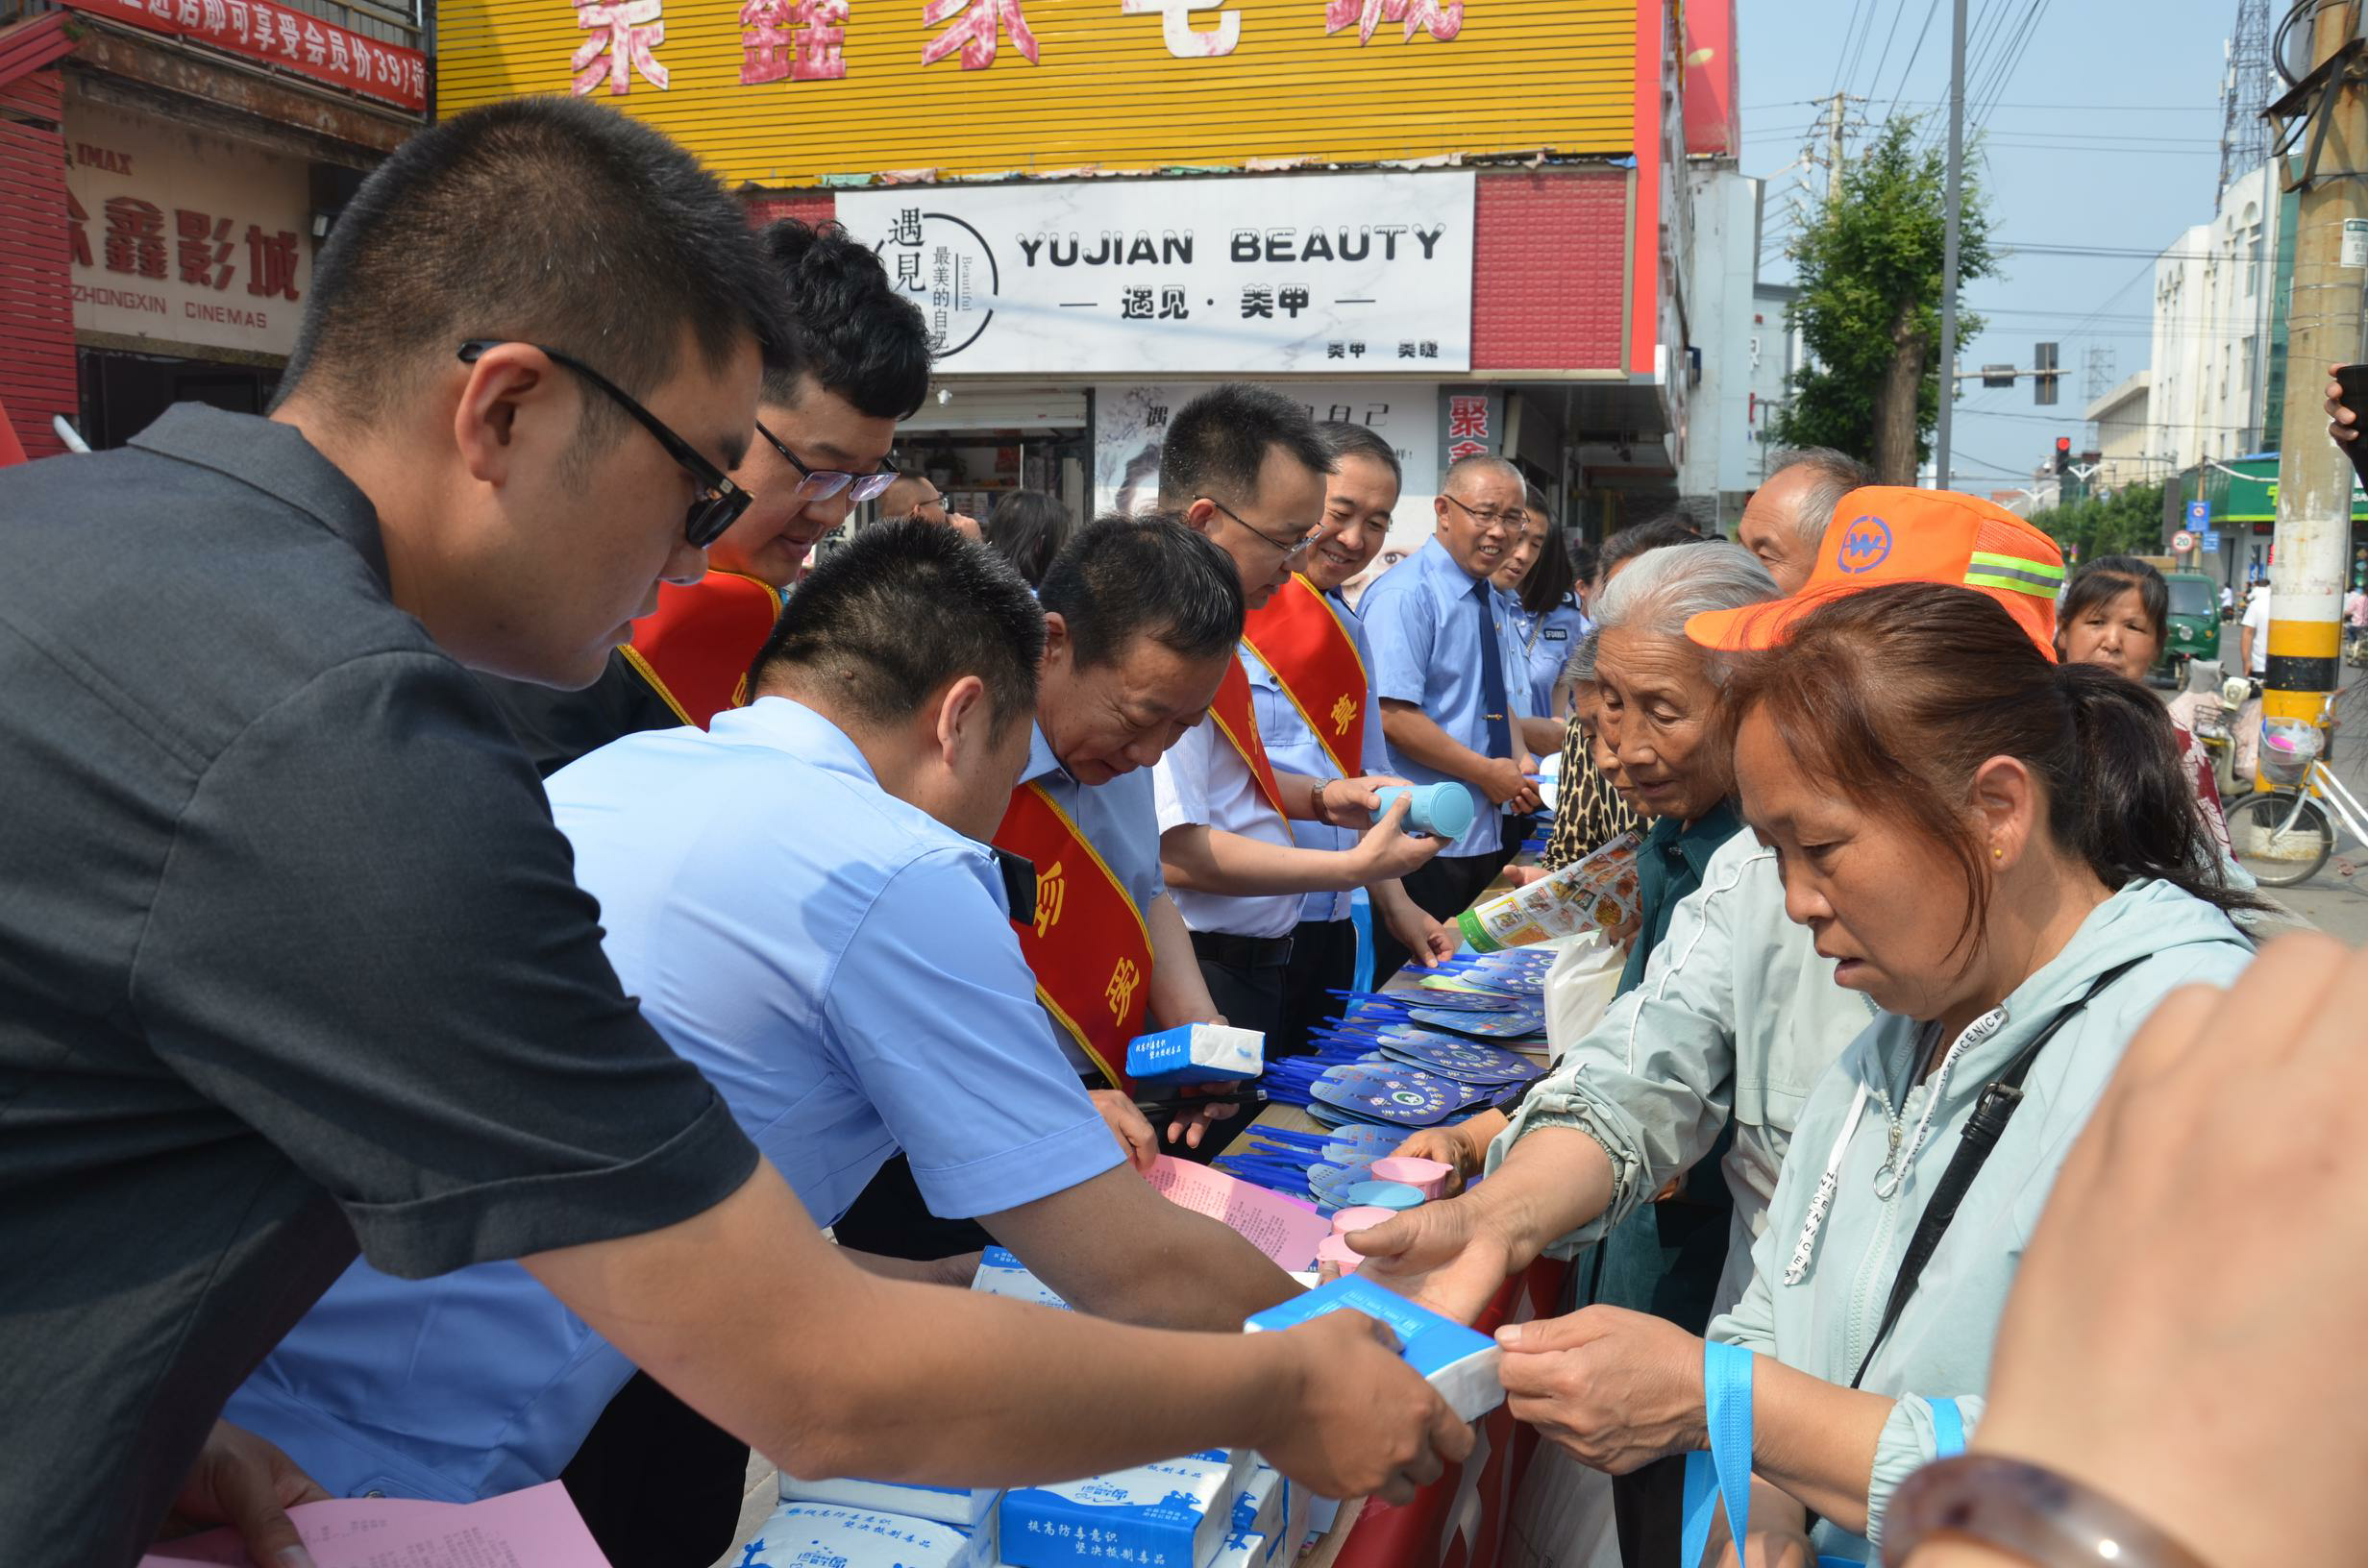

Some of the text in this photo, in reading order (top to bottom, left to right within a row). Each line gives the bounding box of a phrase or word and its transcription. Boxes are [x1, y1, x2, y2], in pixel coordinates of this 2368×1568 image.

[1015, 223, 1446, 267] YUJIAN BEAUTY
[961, 256, 974, 312] Beautiful
[72, 284, 268, 330] ZHONGXIN CINEMAS
[2177, 536, 2190, 547] 20
[1026, 1519, 1119, 1544] 提高防毒意识
